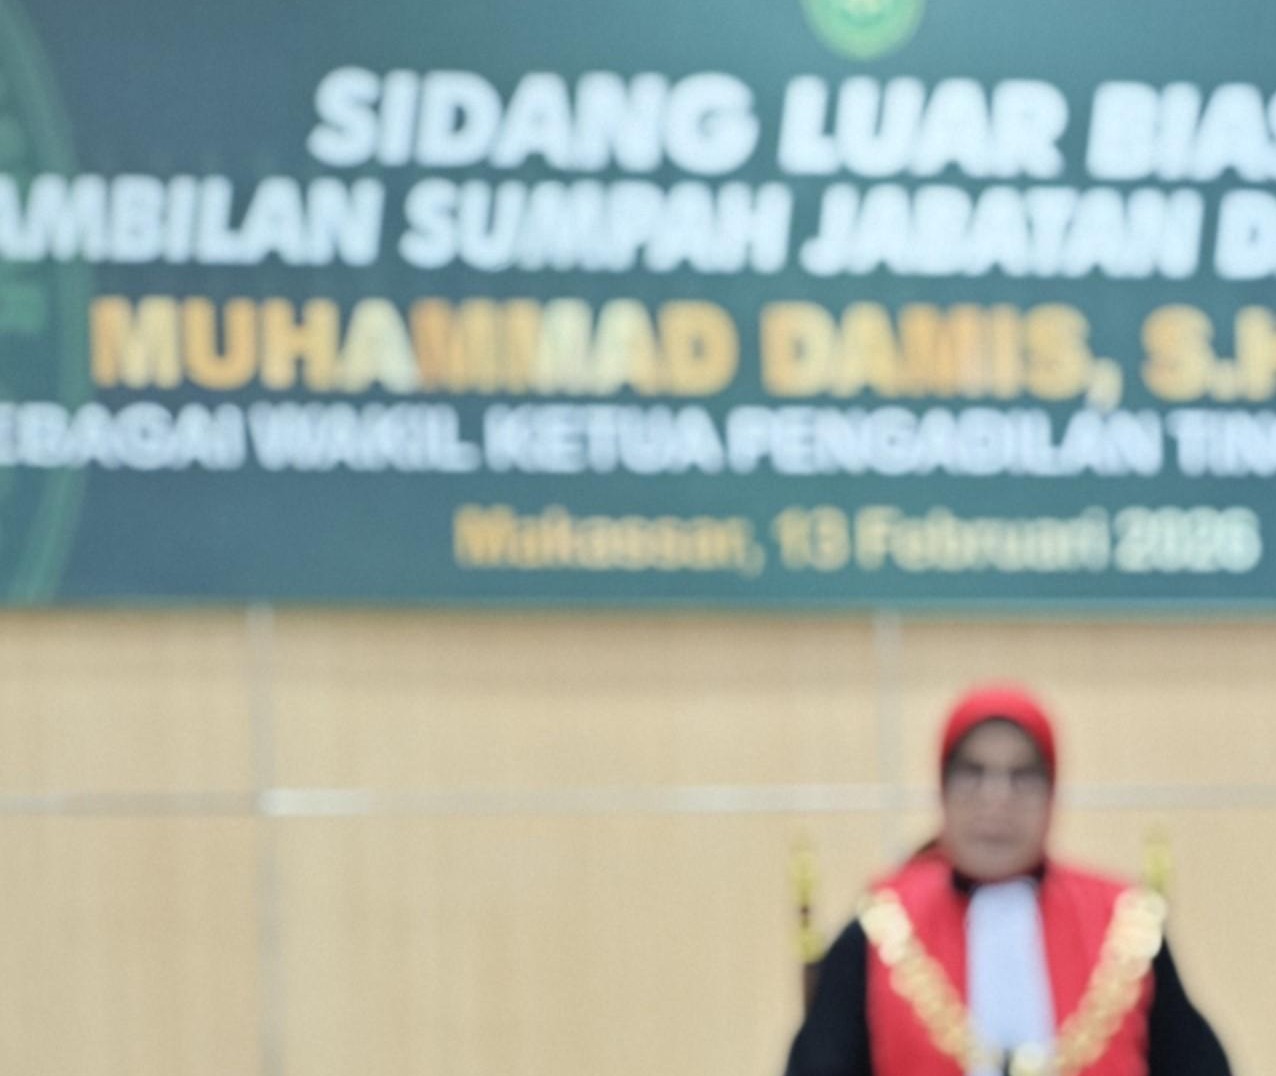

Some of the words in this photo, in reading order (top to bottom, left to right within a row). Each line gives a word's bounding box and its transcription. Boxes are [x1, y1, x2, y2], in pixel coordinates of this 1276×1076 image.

[309, 66, 759, 173] SIDANG
[777, 75, 1067, 178] LUAR
[400, 178, 793, 273] SUMPAH
[801, 183, 1204, 279] JABATAN
[90, 296, 738, 394] MUHAMMAD
[761, 303, 1122, 412] DAMIS,
[248, 400, 480, 472] WAKIL
[483, 405, 724, 475] KETUA
[727, 406, 1162, 477] PENGADILAN
[453, 504, 764, 578] Makassar,
[774, 505, 851, 572] 13
[855, 505, 1110, 573] Februari
[1114, 505, 1263, 573] 2026
